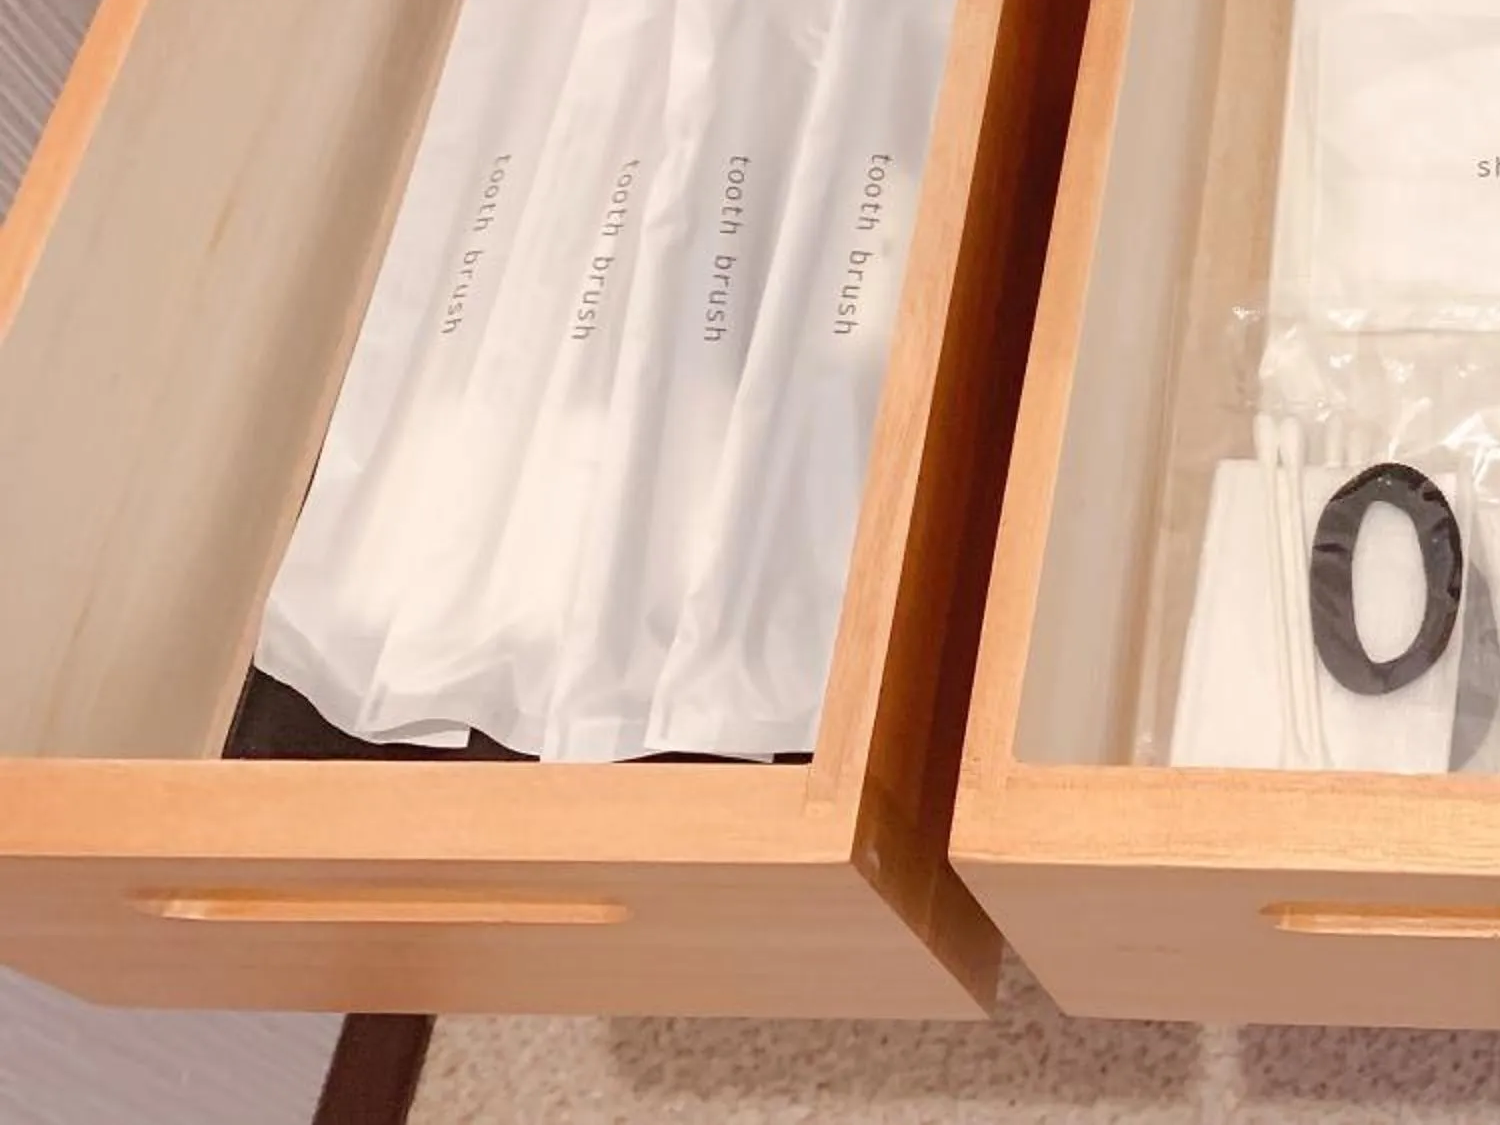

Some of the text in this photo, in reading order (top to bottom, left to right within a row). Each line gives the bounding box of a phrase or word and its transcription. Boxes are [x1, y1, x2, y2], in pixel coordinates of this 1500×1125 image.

[440, 154, 511, 334] tooth brush
[571, 159, 640, 340] tooth brush
[704, 155, 751, 341] tooth brush
[833, 154, 893, 334] tooth brush
